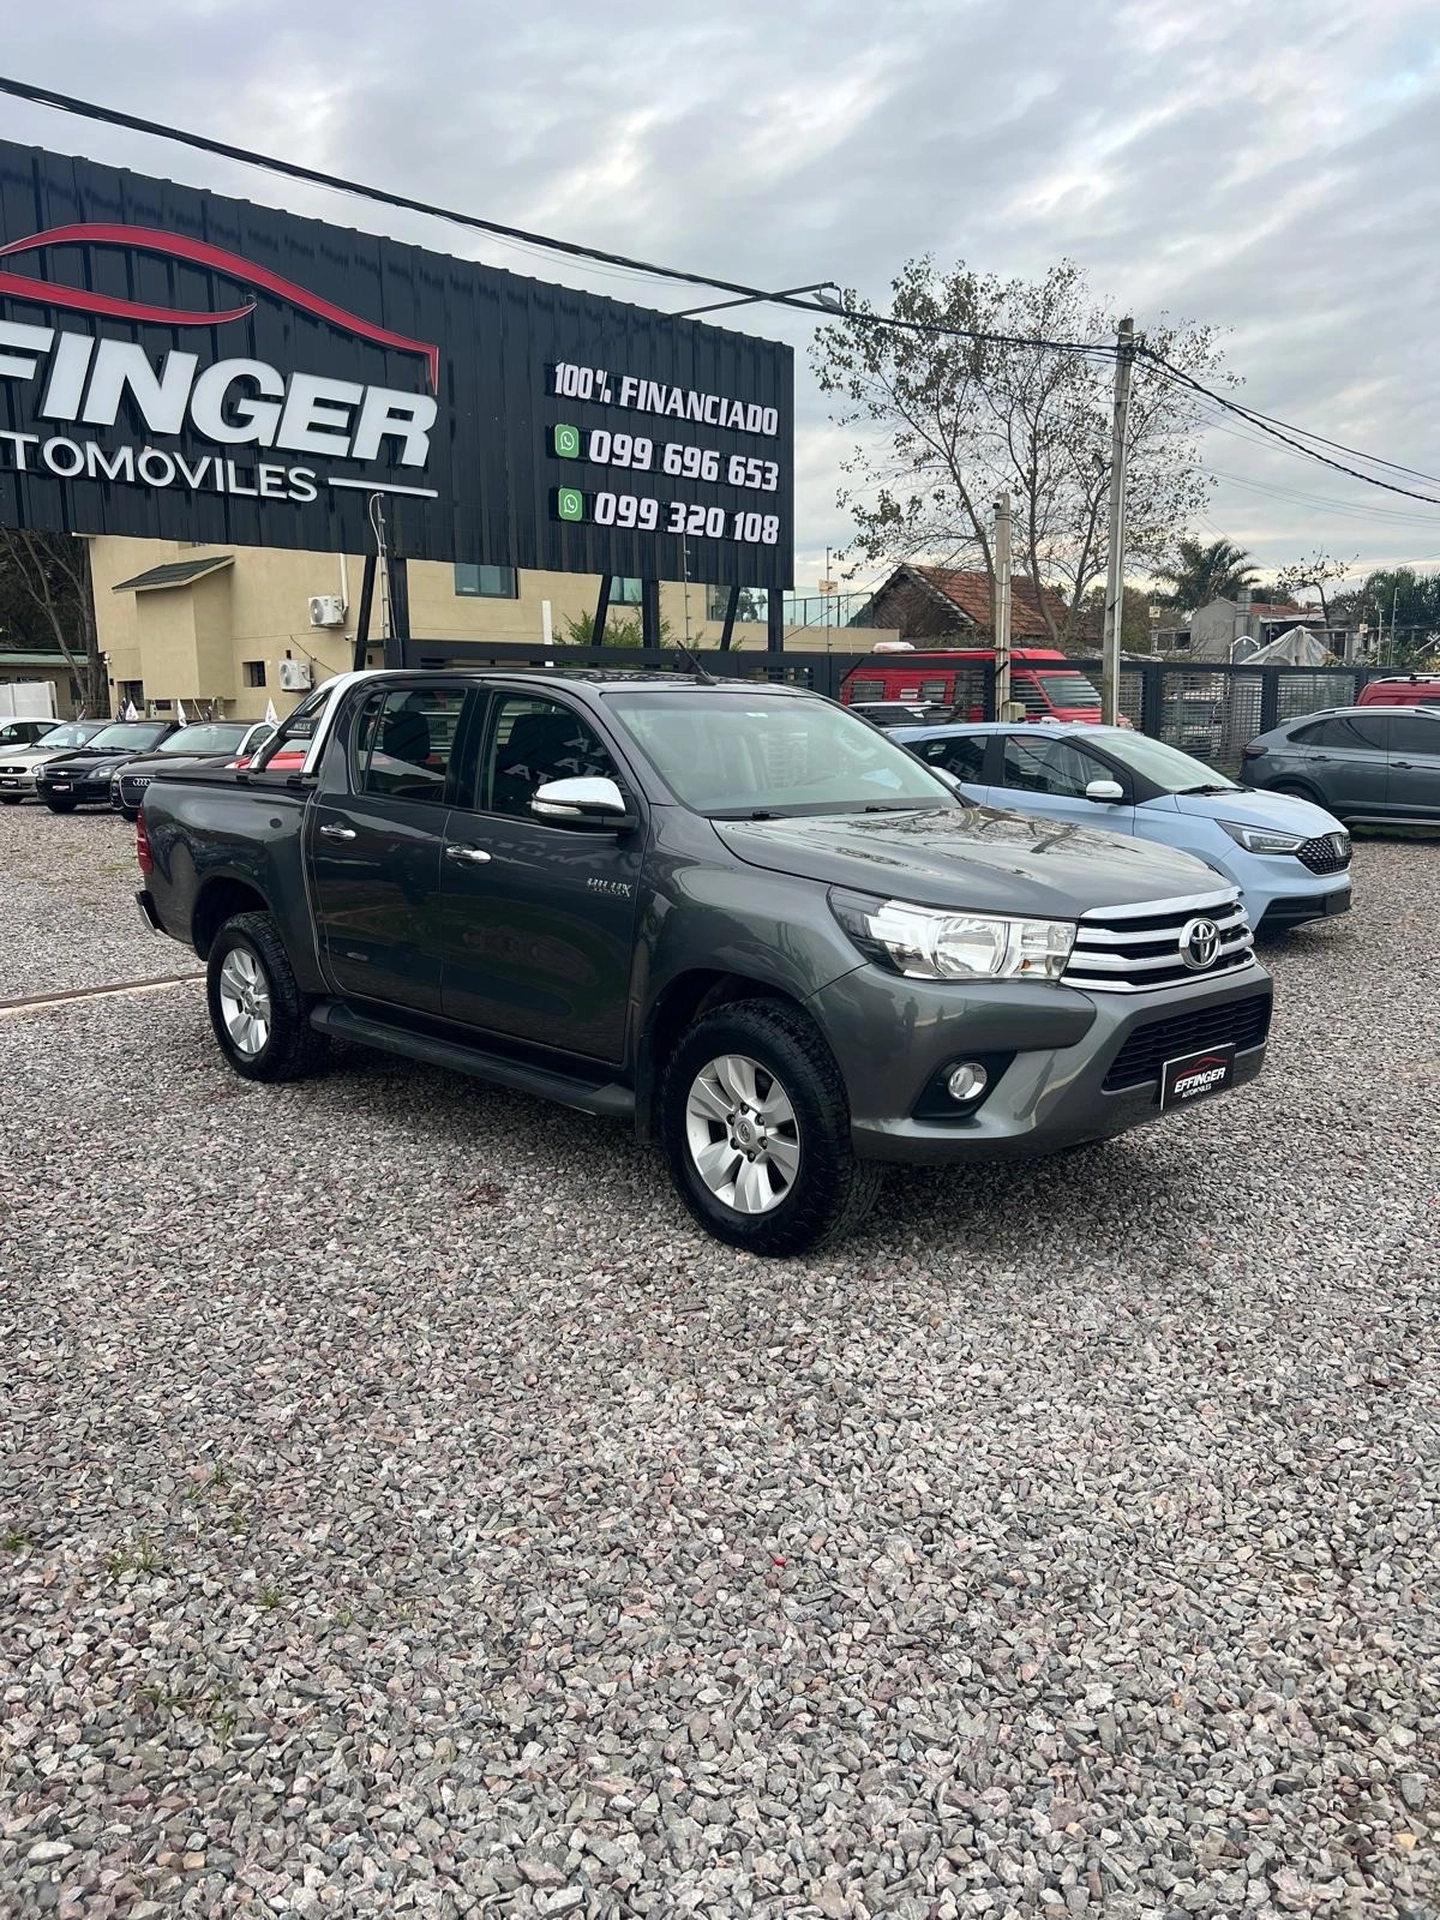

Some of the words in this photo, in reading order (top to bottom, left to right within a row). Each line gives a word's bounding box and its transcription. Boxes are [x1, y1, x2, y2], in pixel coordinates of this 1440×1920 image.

[555, 362, 611, 404] 100%
[619, 376, 778, 436] FINANCIADO
[589, 429, 653, 470] 099
[663, 443, 721, 482] 696
[728, 455, 779, 491] 653
[594, 492, 659, 531] 099
[667, 501, 725, 538] 320
[734, 511, 780, 545] 108
[1174, 1067, 1226, 1093] EFFINGER
